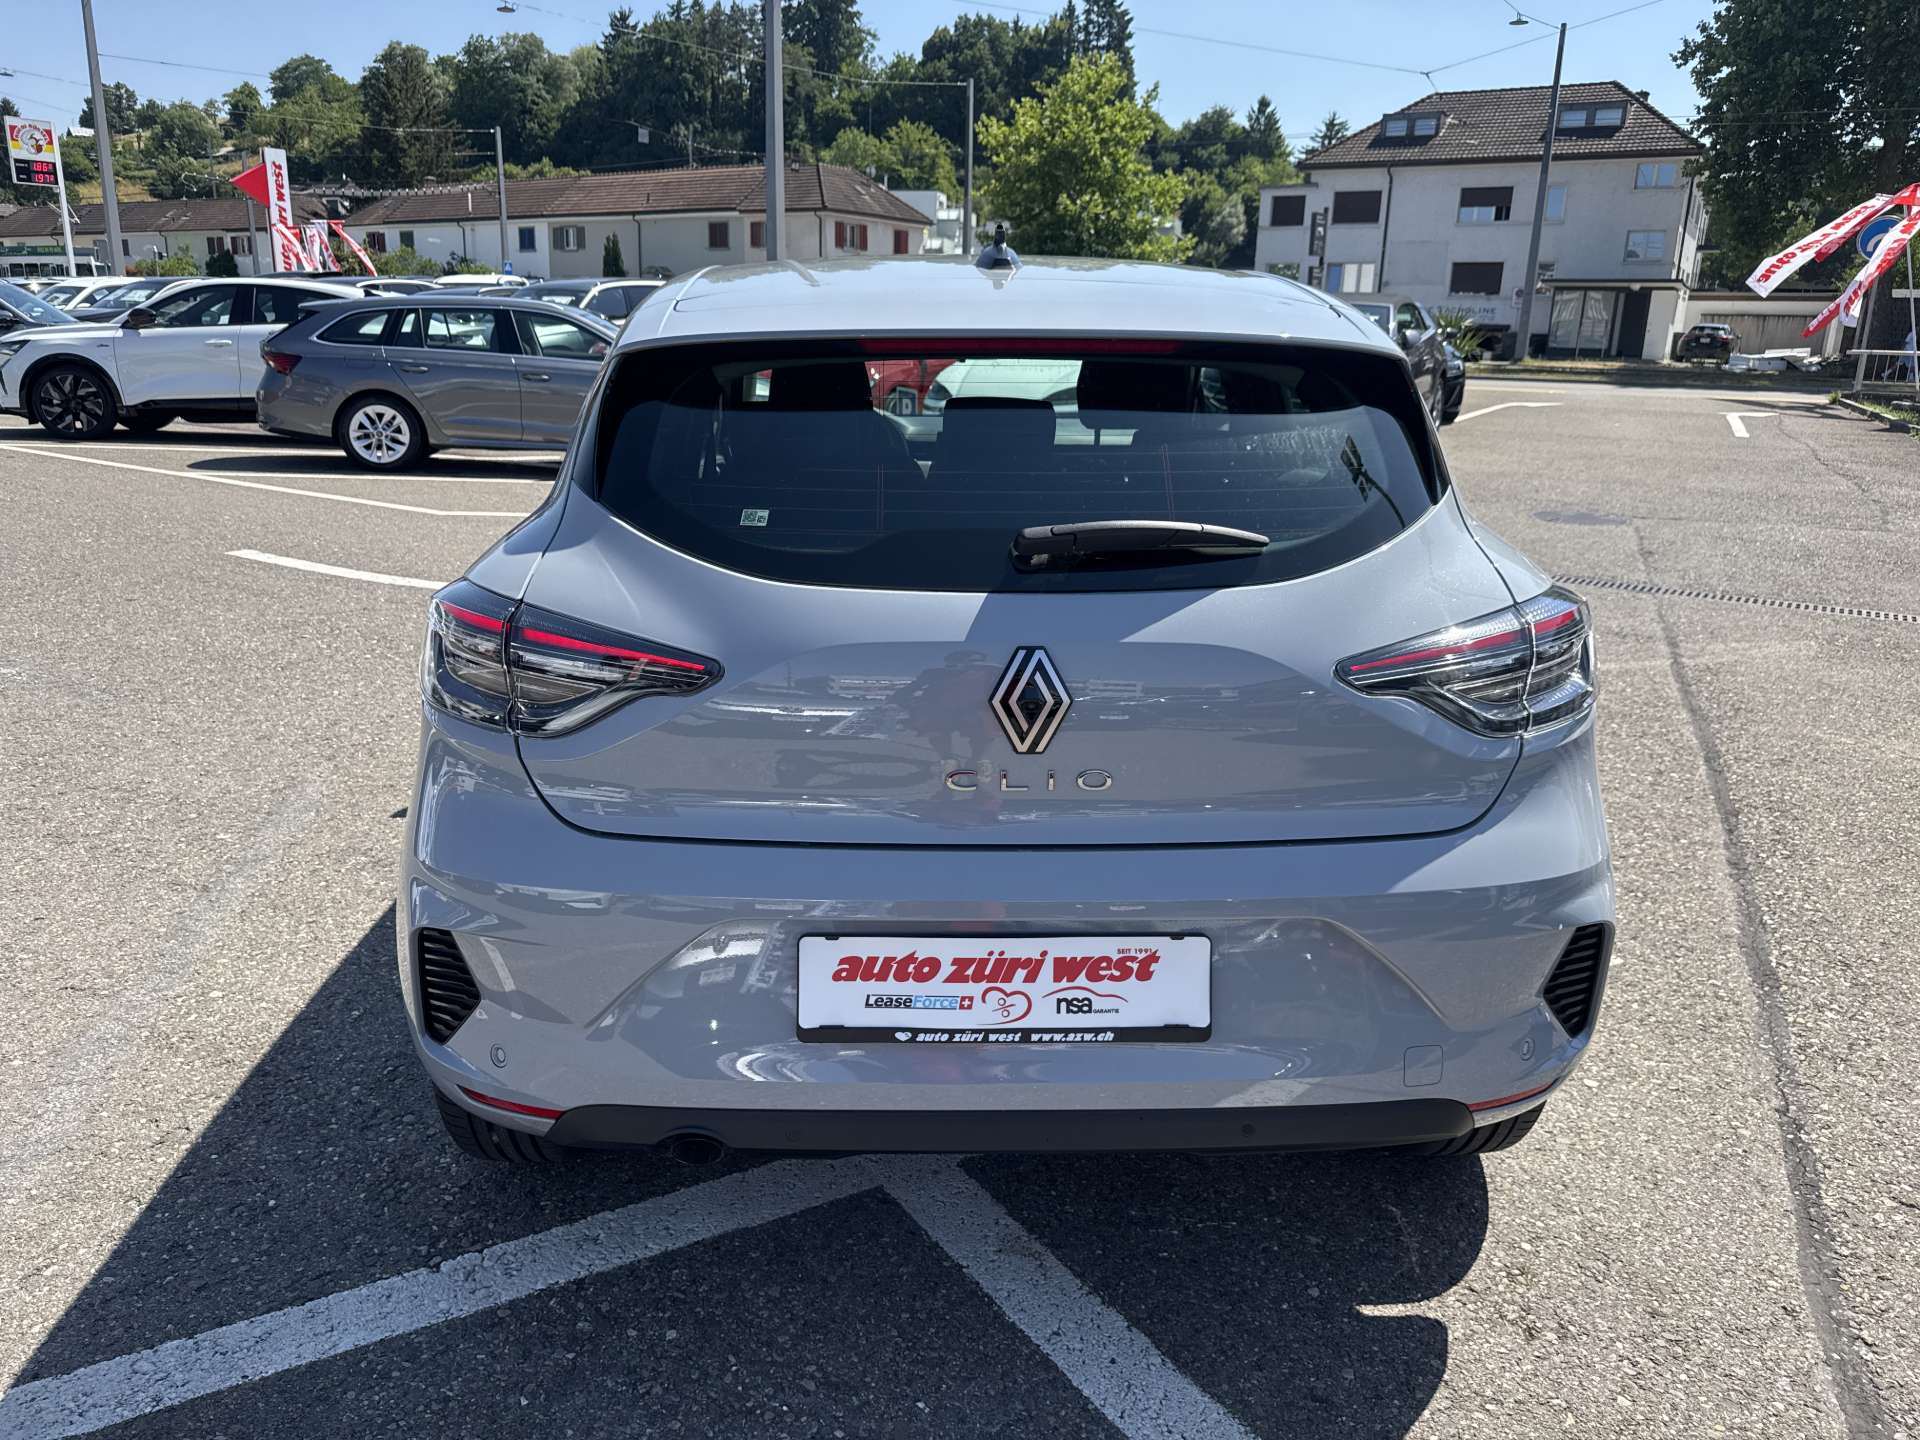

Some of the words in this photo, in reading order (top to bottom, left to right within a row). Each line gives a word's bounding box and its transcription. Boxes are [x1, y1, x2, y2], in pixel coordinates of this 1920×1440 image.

[271, 161, 285, 202] west
[945, 769, 1113, 791] CLIO
[832, 949, 941, 983] auto
[942, 949, 1048, 983] züri
[1053, 949, 1160, 983] west
[865, 994, 958, 1008] LeaseForce
[1057, 997, 1092, 1014] nsa
[915, 1031, 949, 1042] auto
[952, 1030, 984, 1042] züri
[988, 1031, 1022, 1042] west
[1031, 1031, 1114, 1042] www.azw.ch
